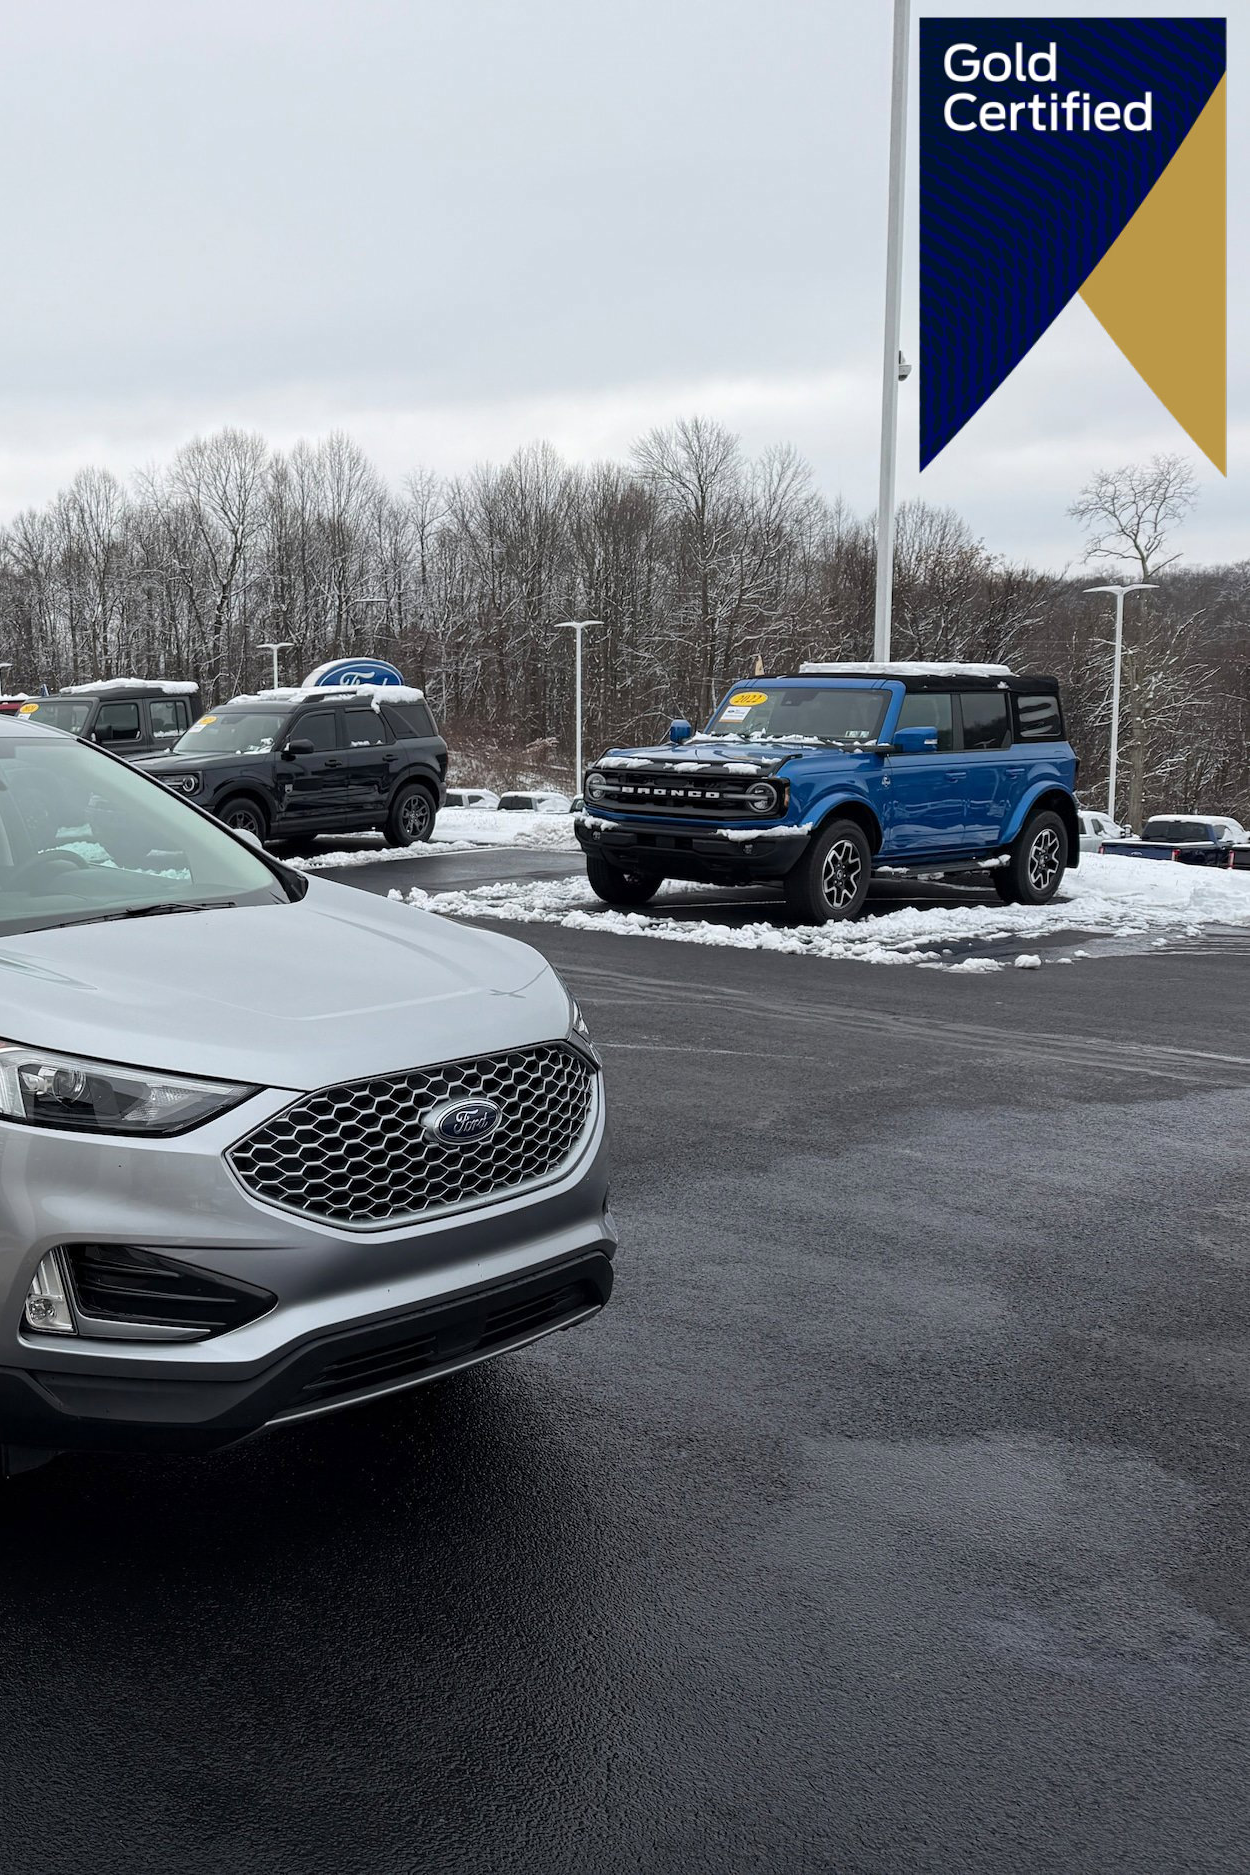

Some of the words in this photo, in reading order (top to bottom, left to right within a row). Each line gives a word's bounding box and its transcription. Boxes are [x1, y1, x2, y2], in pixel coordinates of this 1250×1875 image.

[734, 694, 763, 703] 2022
[621, 786, 720, 798] BRONCO
[454, 1109, 488, 1134] Ford
